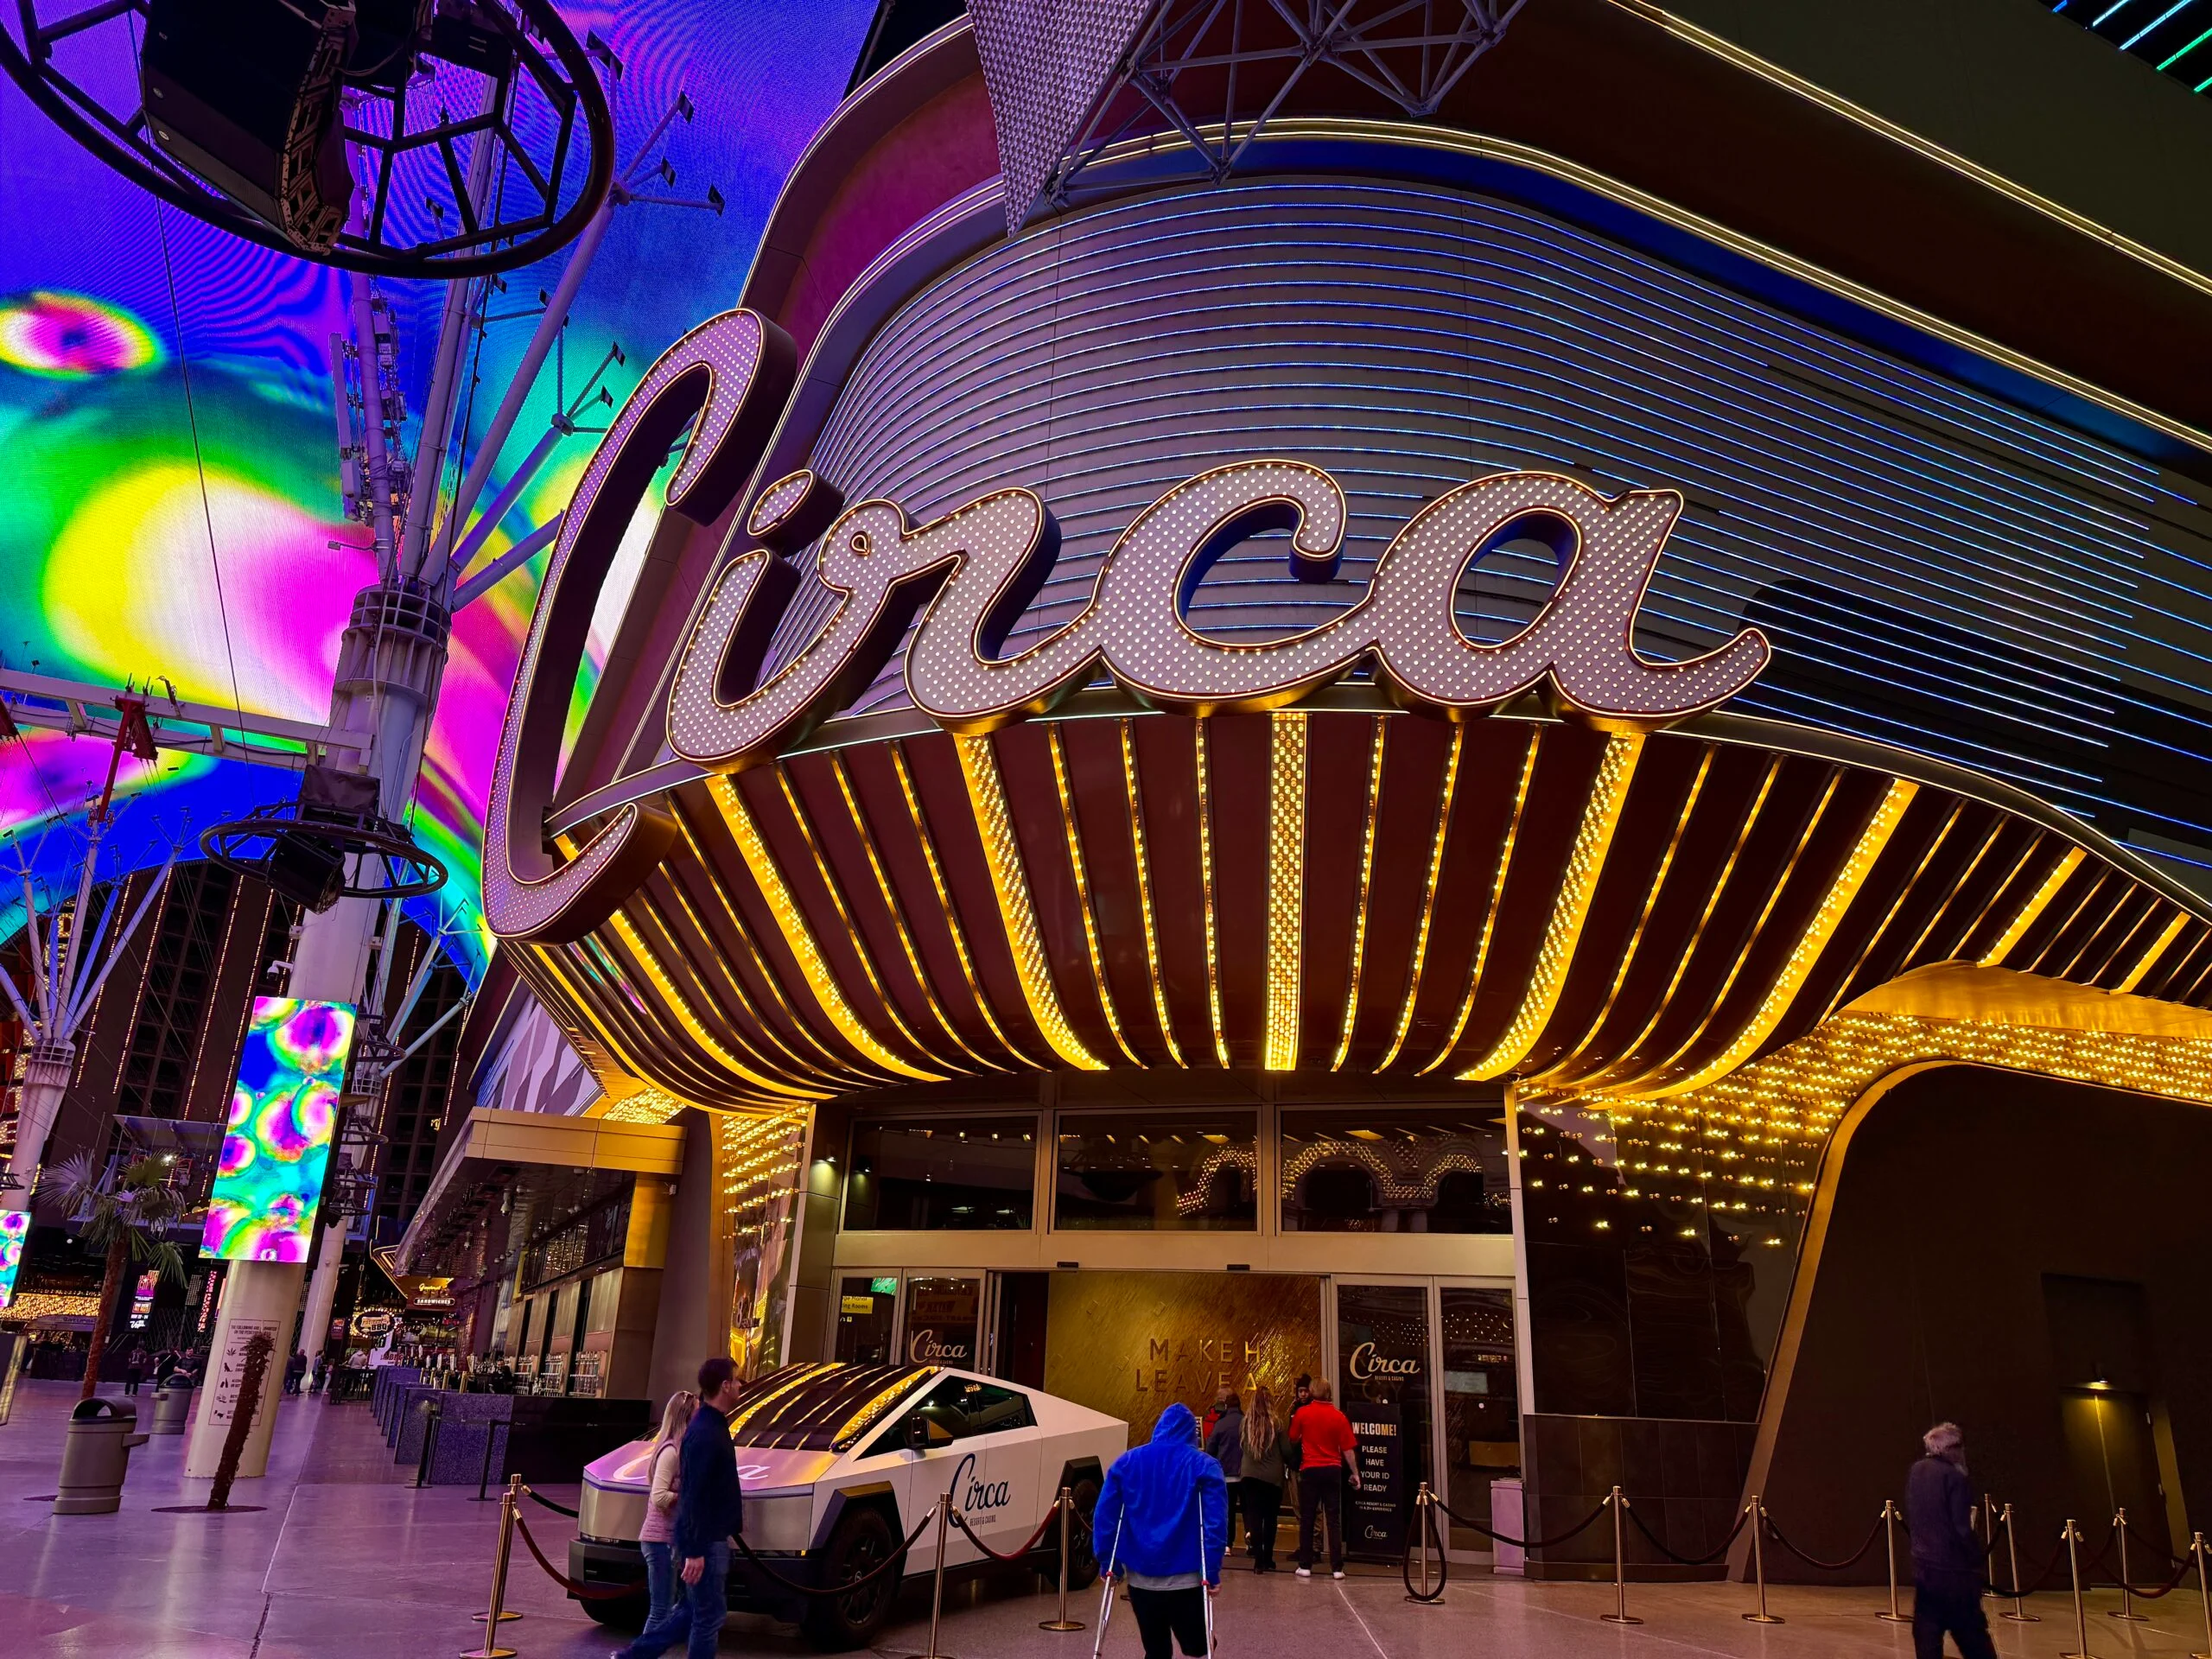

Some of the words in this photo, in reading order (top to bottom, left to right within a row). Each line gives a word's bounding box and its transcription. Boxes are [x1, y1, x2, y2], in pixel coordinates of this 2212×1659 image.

[480, 308, 1772, 945] Circa
[910, 1329, 967, 1363] Circa
[1150, 1338, 1233, 1363] MAKE
[1350, 1341, 1421, 1379] Circa
[1136, 1369, 1232, 1393] LEAVE
[1352, 1421, 1397, 1436] WELCOME!
[948, 1453, 1011, 1528] Circa
[1363, 1484, 1387, 1492] READY
[1364, 1524, 1388, 1538] Circa
